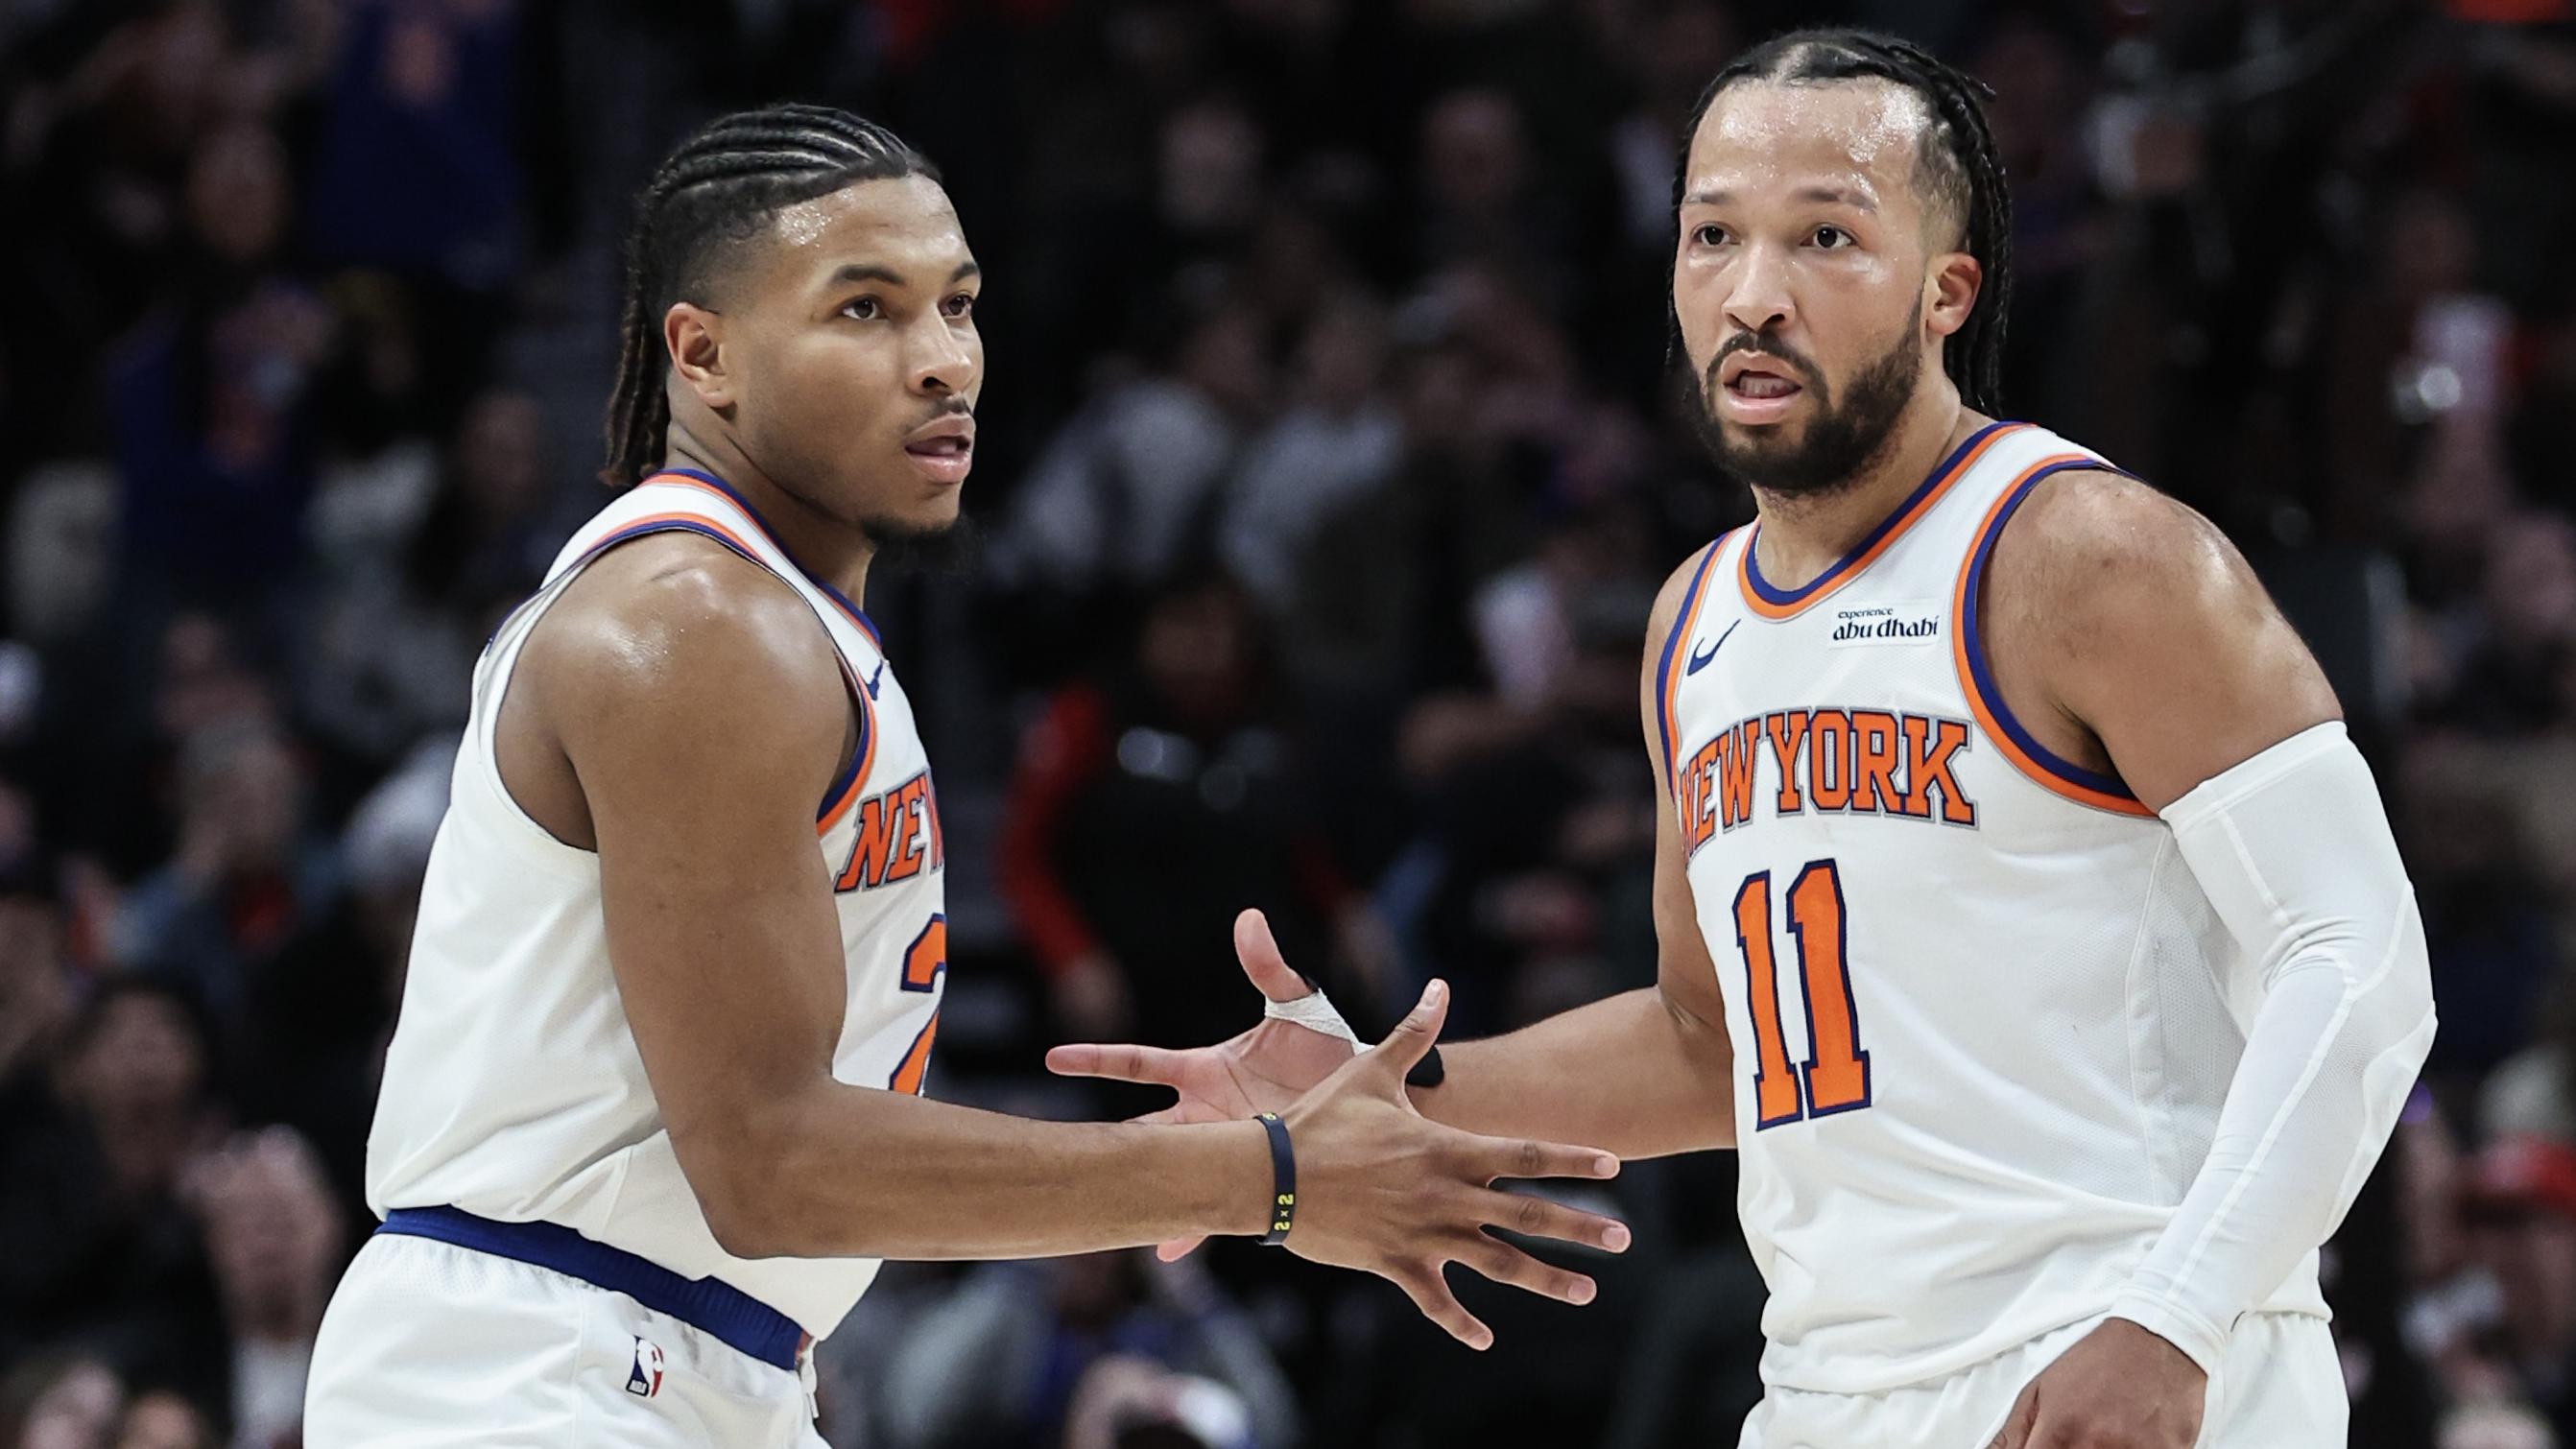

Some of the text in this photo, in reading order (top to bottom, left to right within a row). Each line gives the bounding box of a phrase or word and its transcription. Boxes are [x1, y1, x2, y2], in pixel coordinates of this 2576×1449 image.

[1833, 615, 1939, 640] abu dhabi
[1838, 608, 1893, 619] experience
[1681, 708, 1977, 856] NEW YORK
[1731, 858, 1872, 1131] 11
